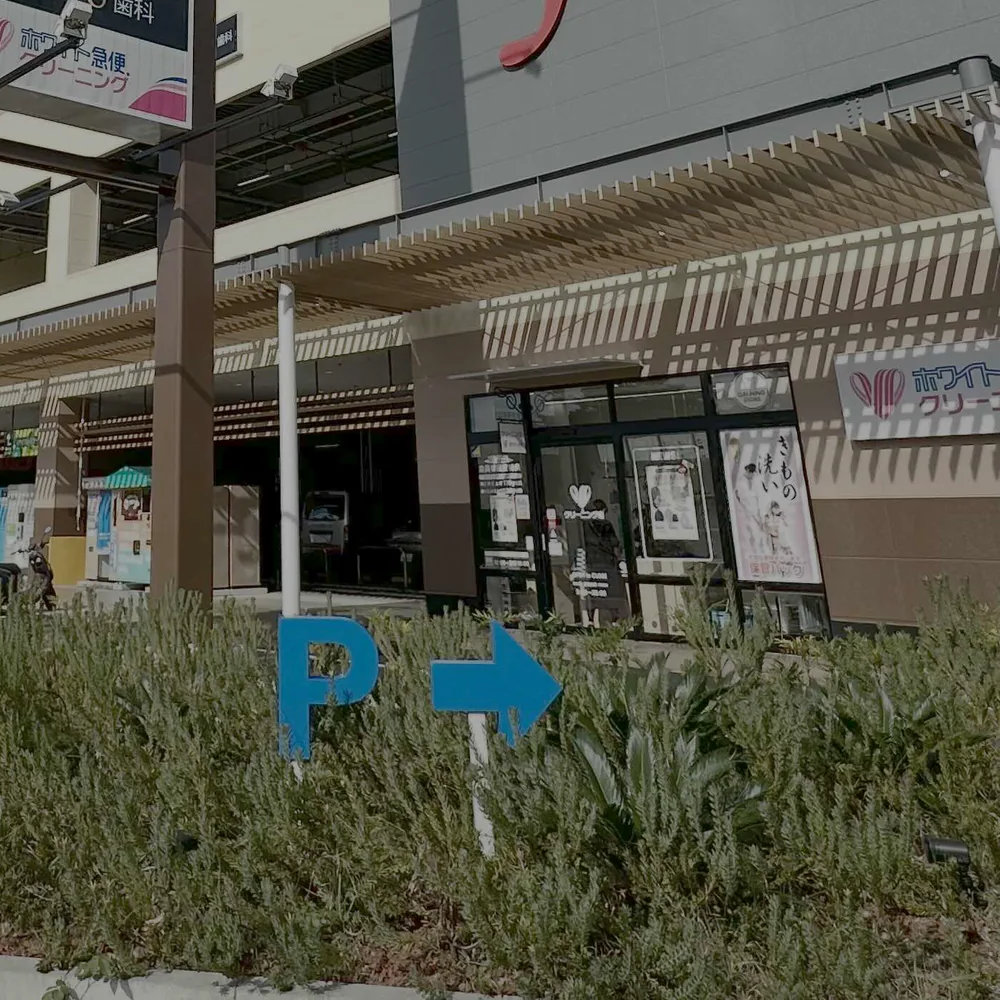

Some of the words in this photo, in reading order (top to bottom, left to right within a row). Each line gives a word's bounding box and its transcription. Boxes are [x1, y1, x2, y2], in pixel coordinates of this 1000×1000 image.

[21, 27, 126, 75] ホワト急便
[758, 453, 778, 493] 洗い
[777, 435, 797, 501] きもの
[278, 616, 379, 761] P
